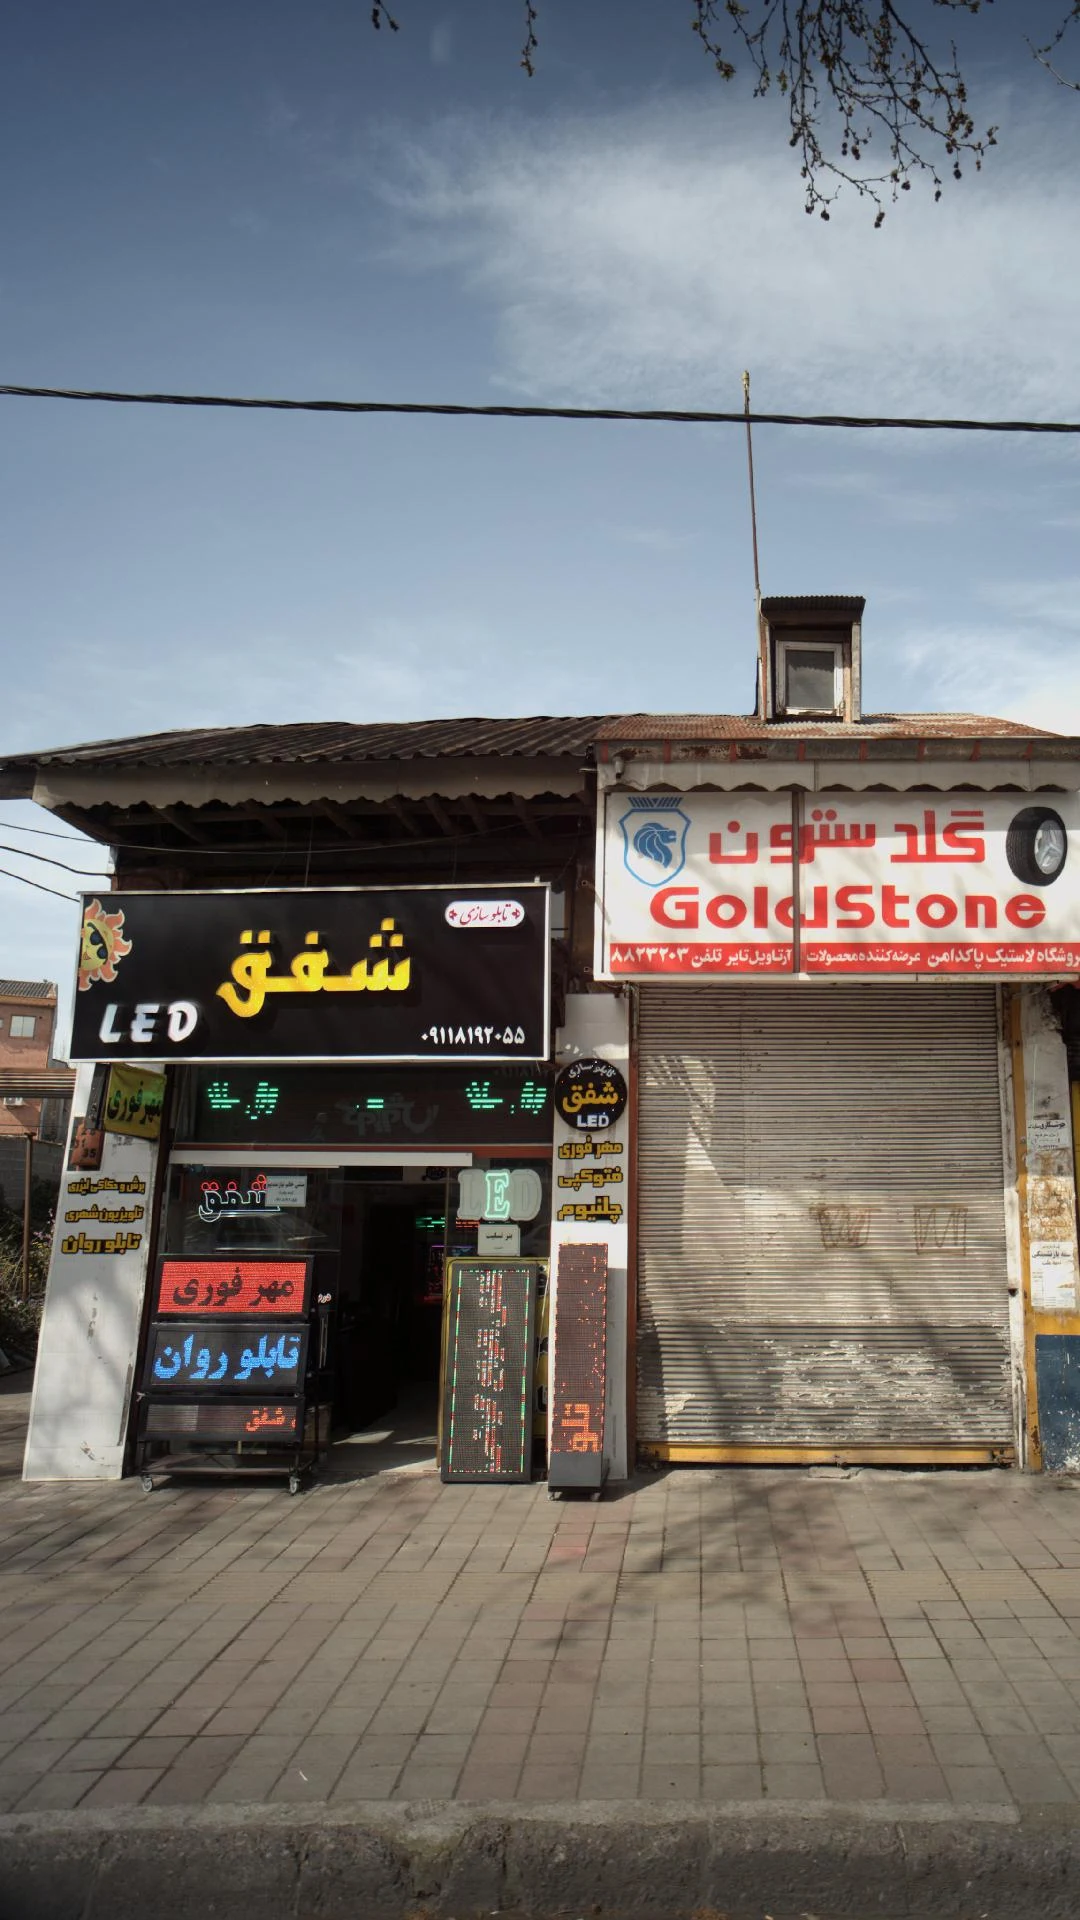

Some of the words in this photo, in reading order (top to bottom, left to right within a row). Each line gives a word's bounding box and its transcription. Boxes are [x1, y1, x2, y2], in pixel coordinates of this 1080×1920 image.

[708, 808, 877, 865] ستون
[891, 809, 985, 864] گلد
[459, 905, 488, 926] سازی
[490, 903, 512, 923] تابلو
[649, 884, 1047, 930] GoldStone
[611, 946, 690, 964] ۸۸۲۳۲۰۳
[691, 948, 723, 968] تلفن
[806, 949, 858, 966] محصولات
[927, 948, 984, 970] پاکدامن
[986, 948, 1035, 967] لاستیک
[1037, 946, 1080, 967] روشگاه
[216, 917, 411, 1018] شفق
[99, 1000, 199, 1044] LED
[421, 1025, 526, 1045] ۰۹۱۱۸۱۹۲۰۵۵
[107, 1080, 143, 1121] فوری
[562, 1081, 619, 1113] شفق
[576, 1114, 610, 1127] LED
[558, 1135, 593, 1159] فوری
[594, 1141, 624, 1159] مهر
[558, 1166, 624, 1191] فتوکپی
[457, 1168, 542, 1221] LED
[65, 1204, 99, 1223] شهری
[98, 1205, 144, 1223] تلویزیون
[61, 1232, 102, 1254] روان
[104, 1232, 142, 1255] تابلو
[172, 1266, 244, 1306] فوری
[248, 1280, 295, 1306] مهر
[153, 1333, 229, 1379] روان
[234, 1333, 300, 1380] تابلو
